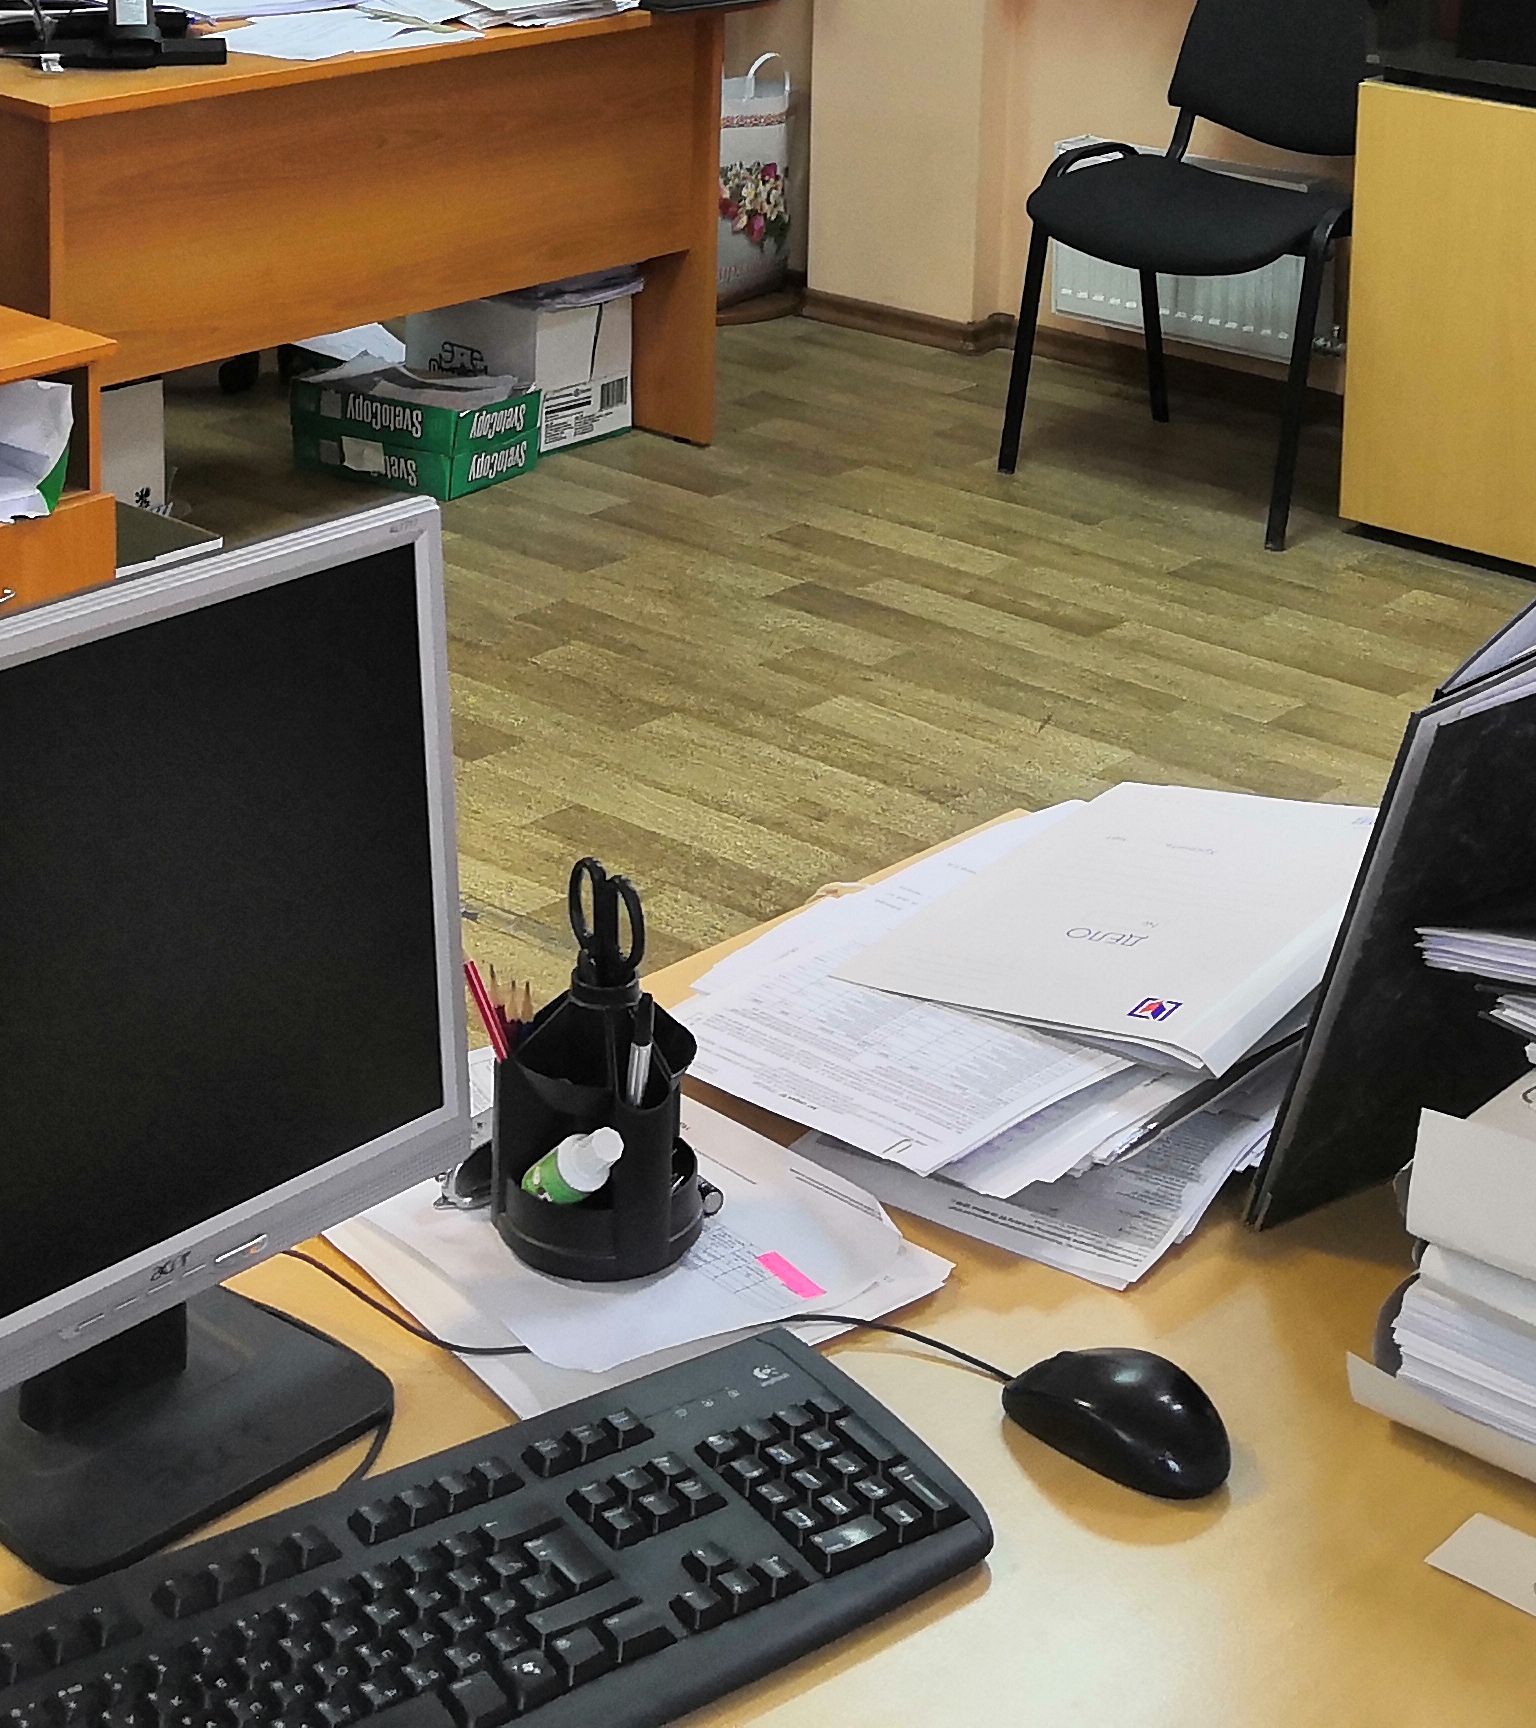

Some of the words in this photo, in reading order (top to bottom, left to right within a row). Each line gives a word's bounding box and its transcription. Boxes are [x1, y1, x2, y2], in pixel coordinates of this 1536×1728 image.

[347, 393, 422, 438] SvetoCopy
[470, 404, 526, 439] SvetoCopy
[468, 441, 527, 481] SvetoCopy
[1066, 927, 1149, 947] ДЕЛО
